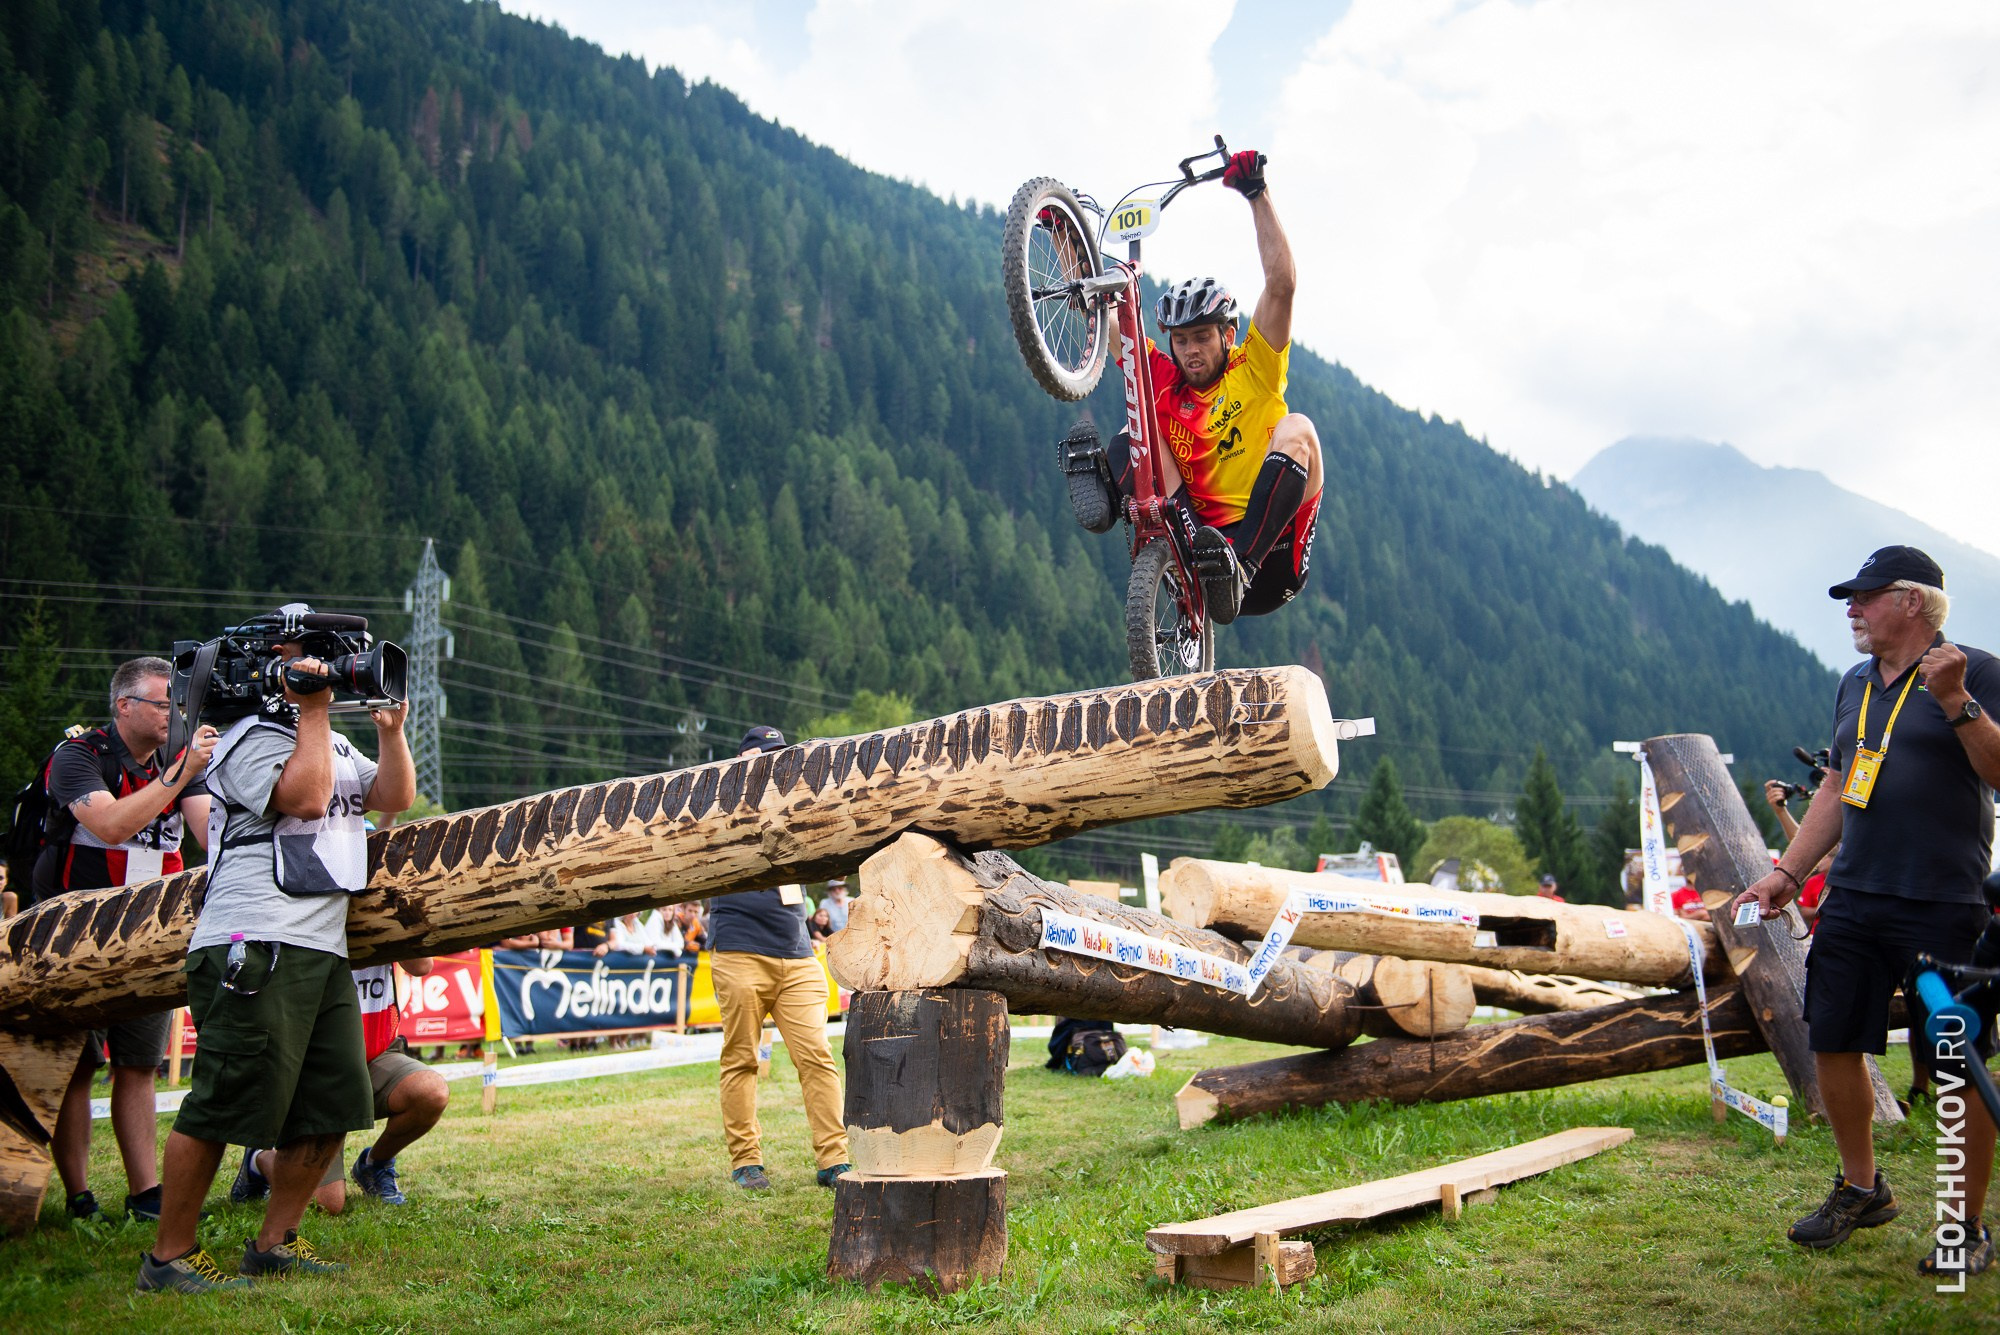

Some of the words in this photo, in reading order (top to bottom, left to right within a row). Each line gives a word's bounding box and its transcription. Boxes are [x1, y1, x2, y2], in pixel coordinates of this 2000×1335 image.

[1117, 210, 1142, 230] 101
[1045, 918, 1077, 947] TRENTINO
[1115, 936, 1143, 962] TRENTINO
[1249, 932, 1283, 983] TRENTINO
[355, 977, 385, 1000] TO
[520, 958, 673, 1021] Melinda
